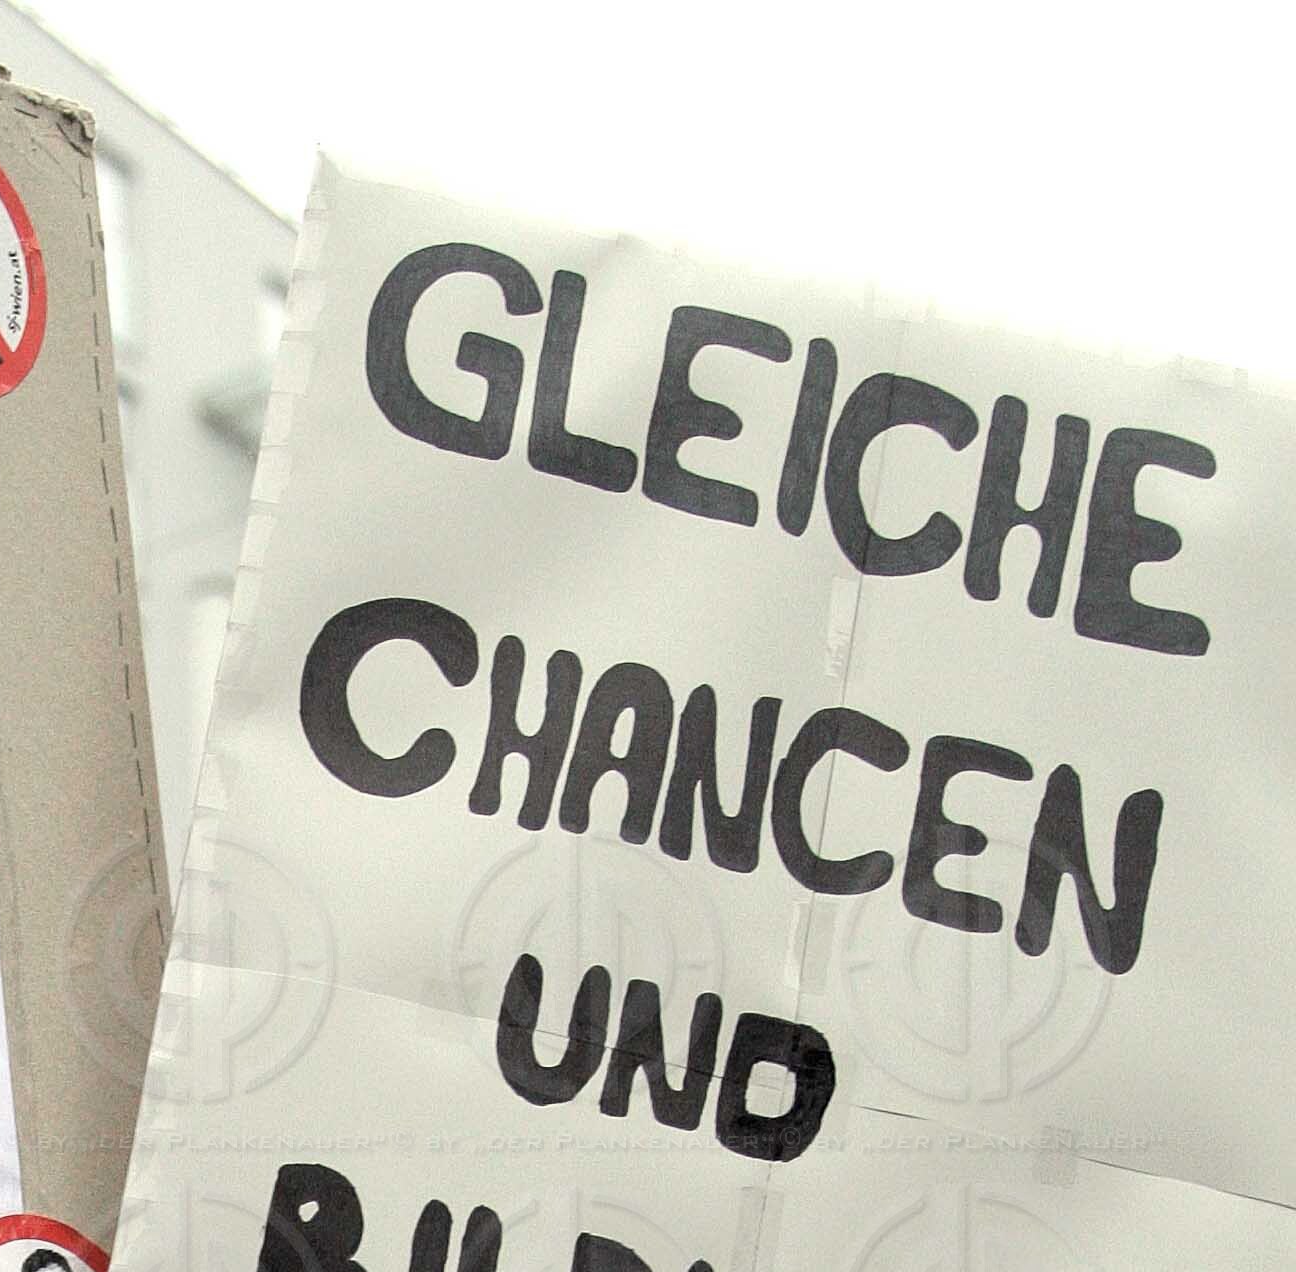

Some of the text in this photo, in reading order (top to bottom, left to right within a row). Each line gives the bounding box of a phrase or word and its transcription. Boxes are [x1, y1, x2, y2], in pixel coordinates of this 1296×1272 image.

[365, 242, 1216, 657] GLEICHE
[299, 597, 1164, 975] CHANCEN
[496, 953, 837, 1163] UND
